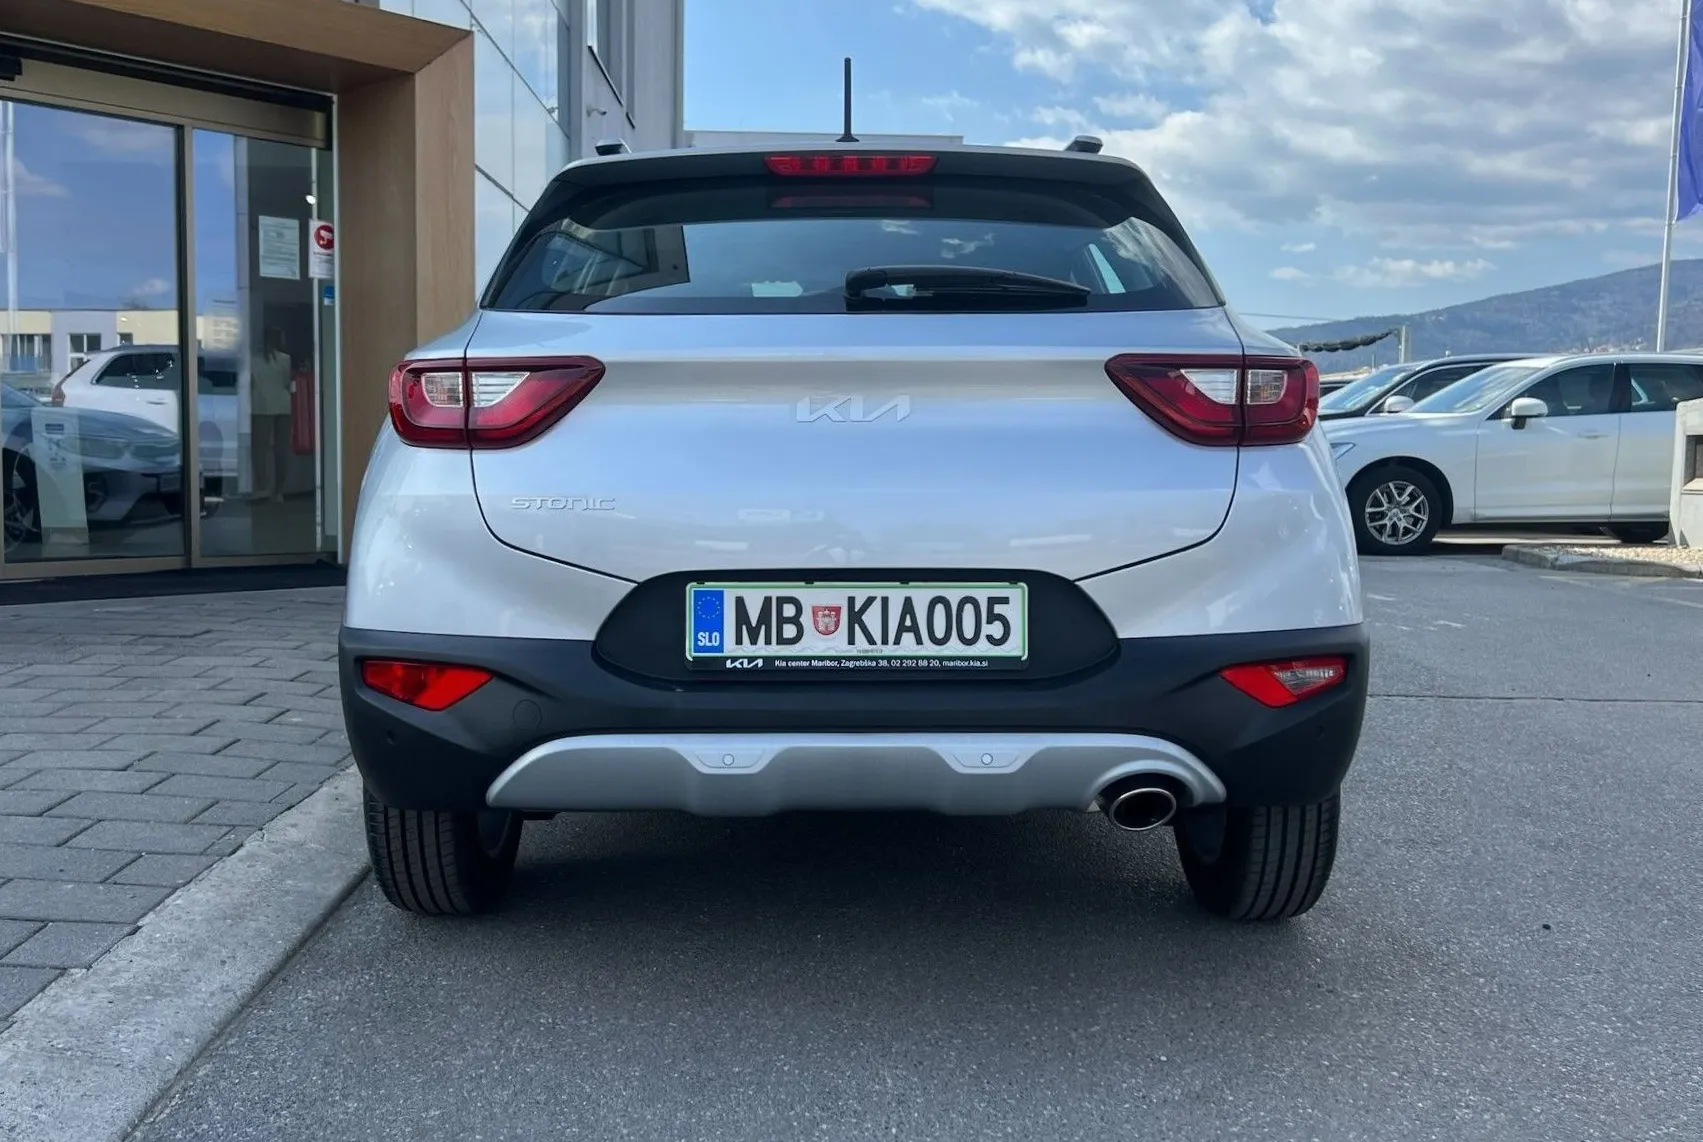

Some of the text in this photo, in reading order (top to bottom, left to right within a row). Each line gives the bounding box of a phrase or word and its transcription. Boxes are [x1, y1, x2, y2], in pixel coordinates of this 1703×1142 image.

[796, 394, 911, 423] KIA
[735, 595, 1012, 647] MB KIA005
[697, 631, 720, 647] SLO
[725, 658, 763, 669] KIA
[775, 659, 786, 667] Kia
[811, 659, 840, 668] Maribor,
[891, 659, 900, 667] 02
[902, 659, 916, 667] 292
[918, 659, 928, 667] 88
[929, 659, 941, 668] 20,
[943, 659, 988, 667] maribor.kia.si
